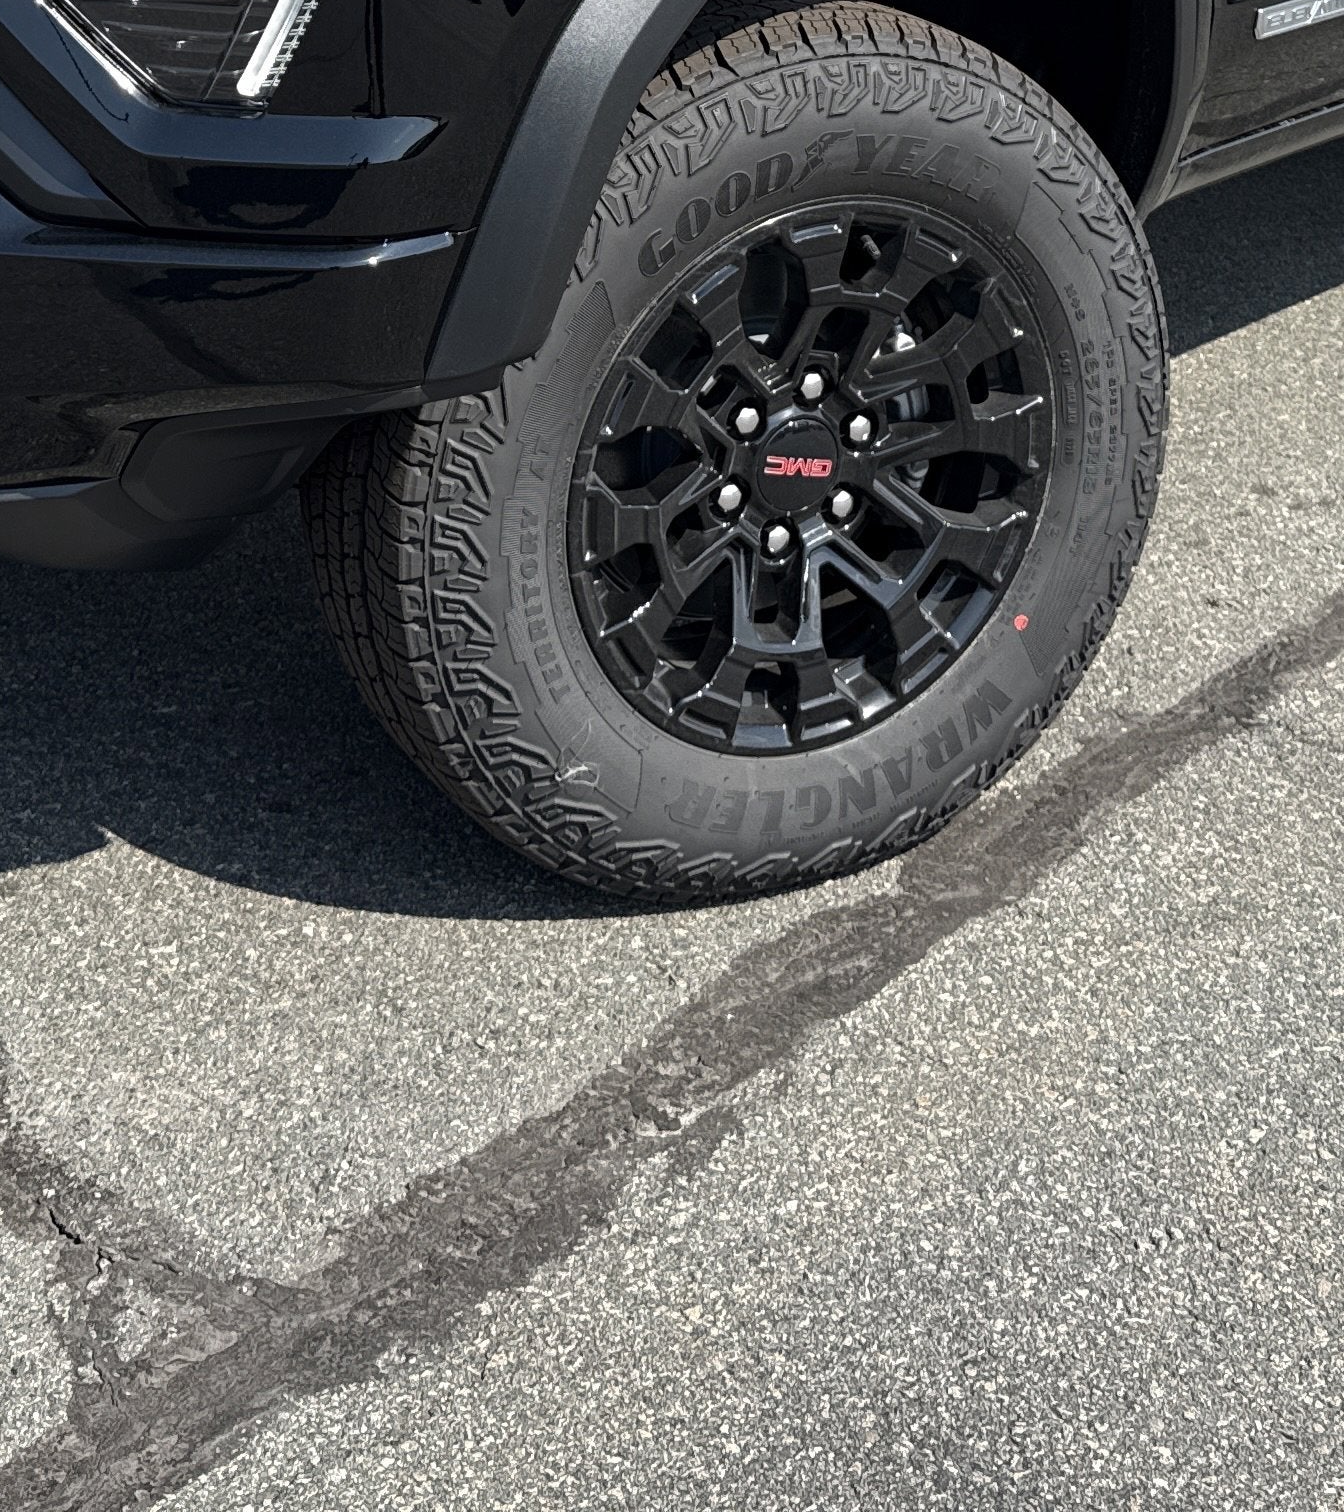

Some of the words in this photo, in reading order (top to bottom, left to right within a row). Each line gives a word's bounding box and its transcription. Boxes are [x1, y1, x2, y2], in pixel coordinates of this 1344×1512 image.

[763, 455, 833, 477] GMC
[519, 505, 572, 705] TERRITORY
[664, 679, 1013, 835] WRANGLER
